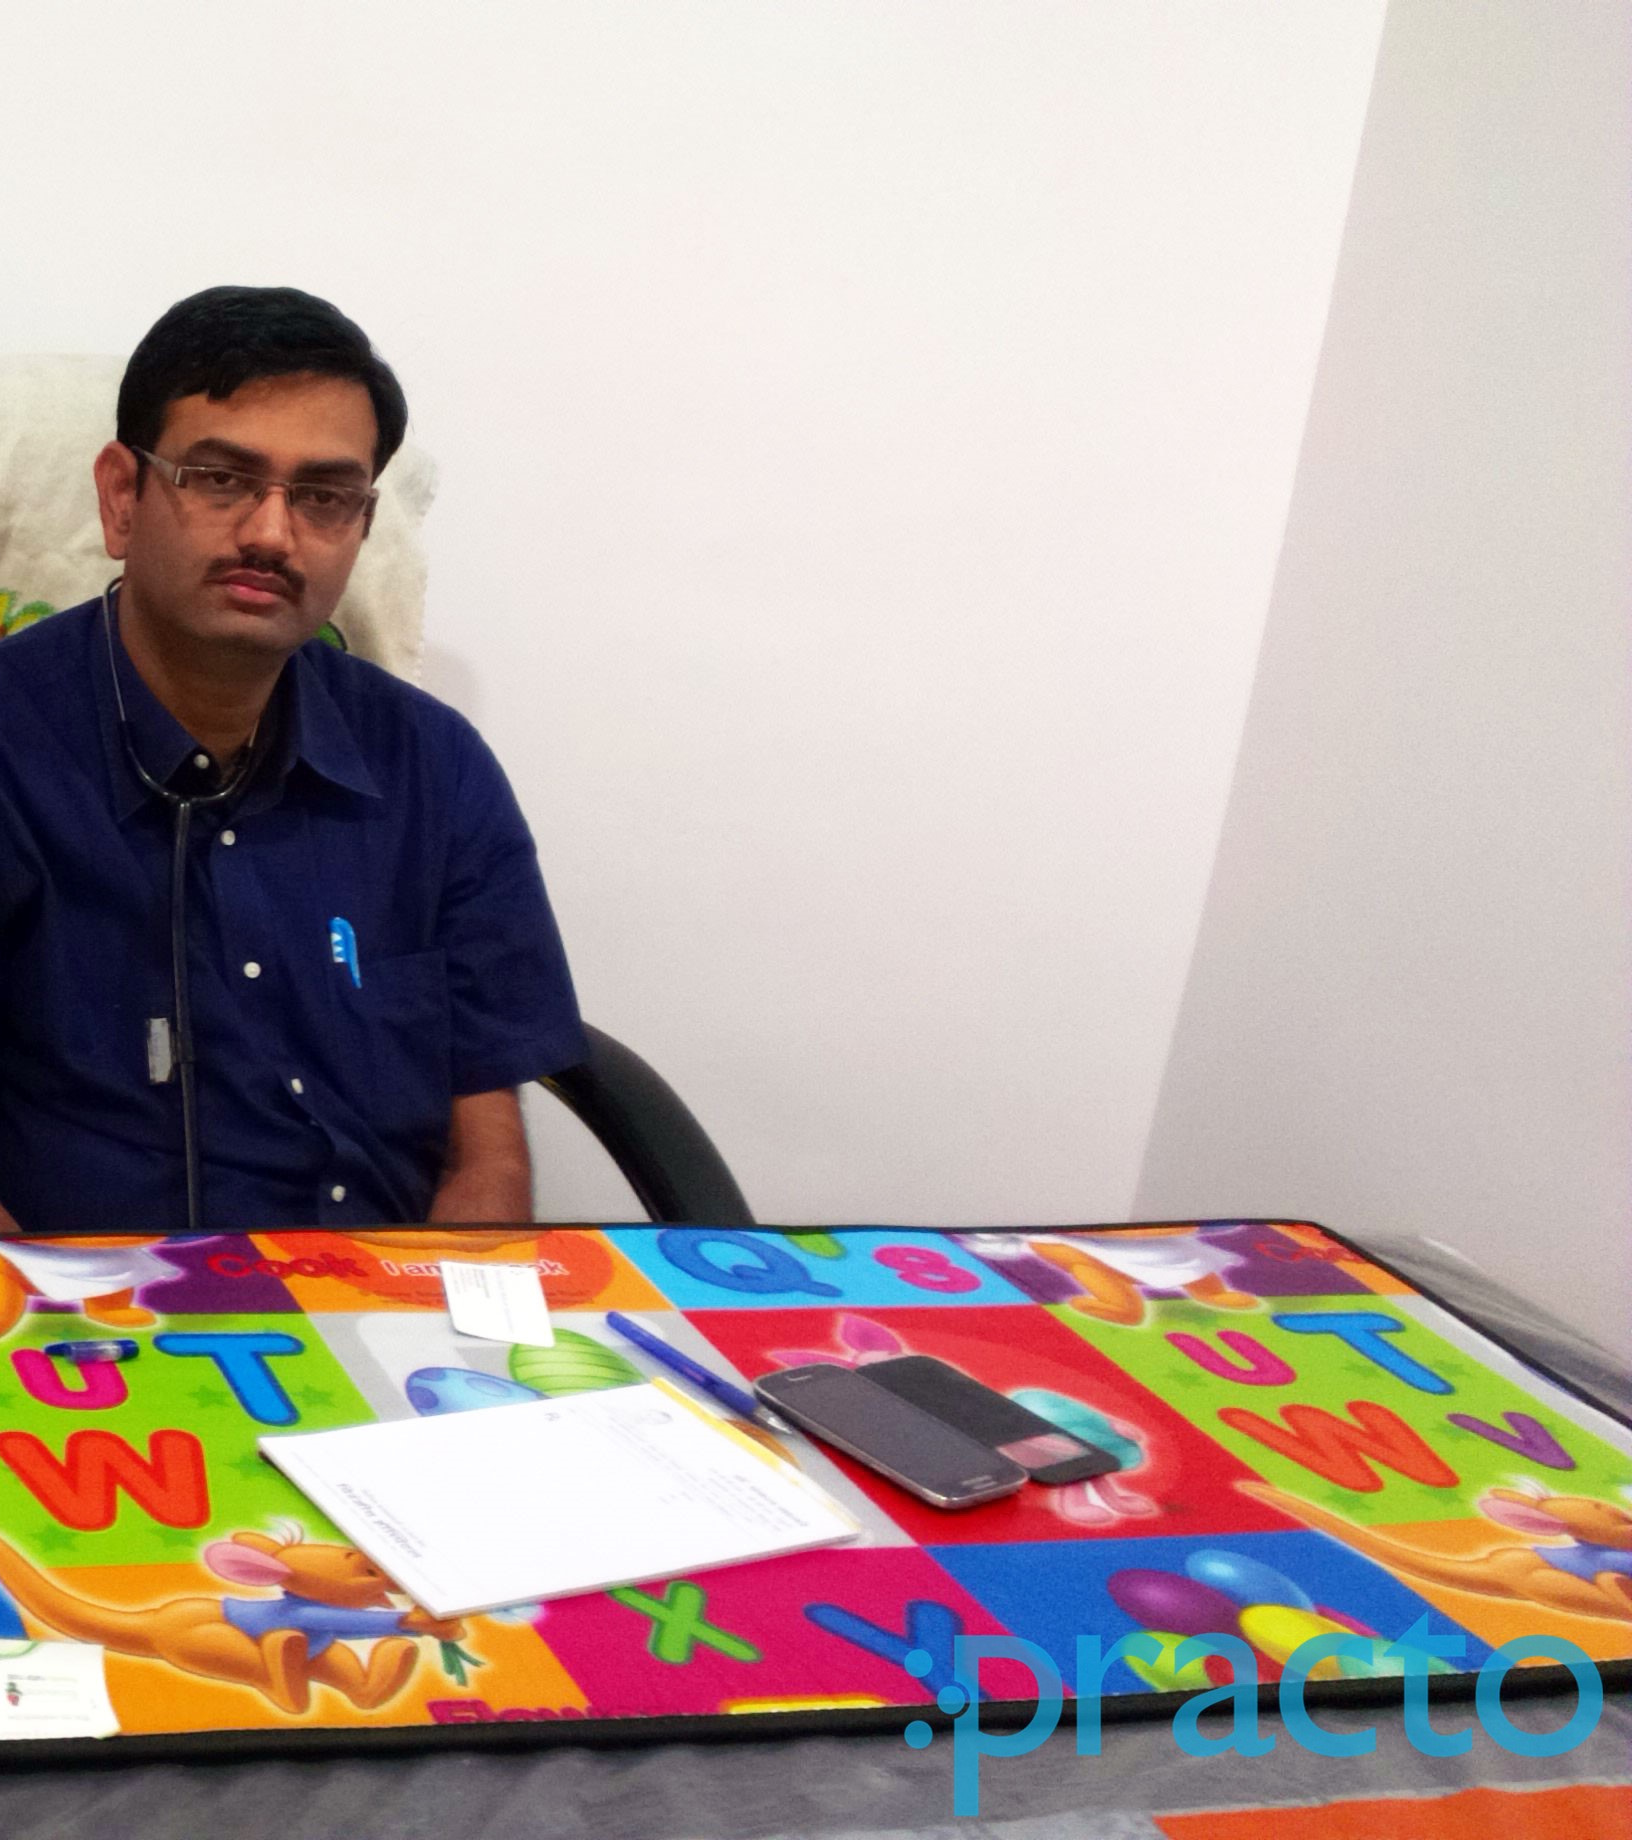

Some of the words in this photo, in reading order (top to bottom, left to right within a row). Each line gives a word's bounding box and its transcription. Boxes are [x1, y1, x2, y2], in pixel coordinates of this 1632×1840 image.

[207, 1252, 369, 1279] Cook
[656, 1229, 844, 1295] Q
[10, 1344, 128, 1410] U
[152, 1332, 305, 1426] T
[1165, 1330, 1297, 1387] U
[1271, 1311, 1456, 1396] T
[1217, 1400, 1462, 1494] W
[1446, 1411, 1577, 1472] V
[606, 1580, 765, 1666] X
